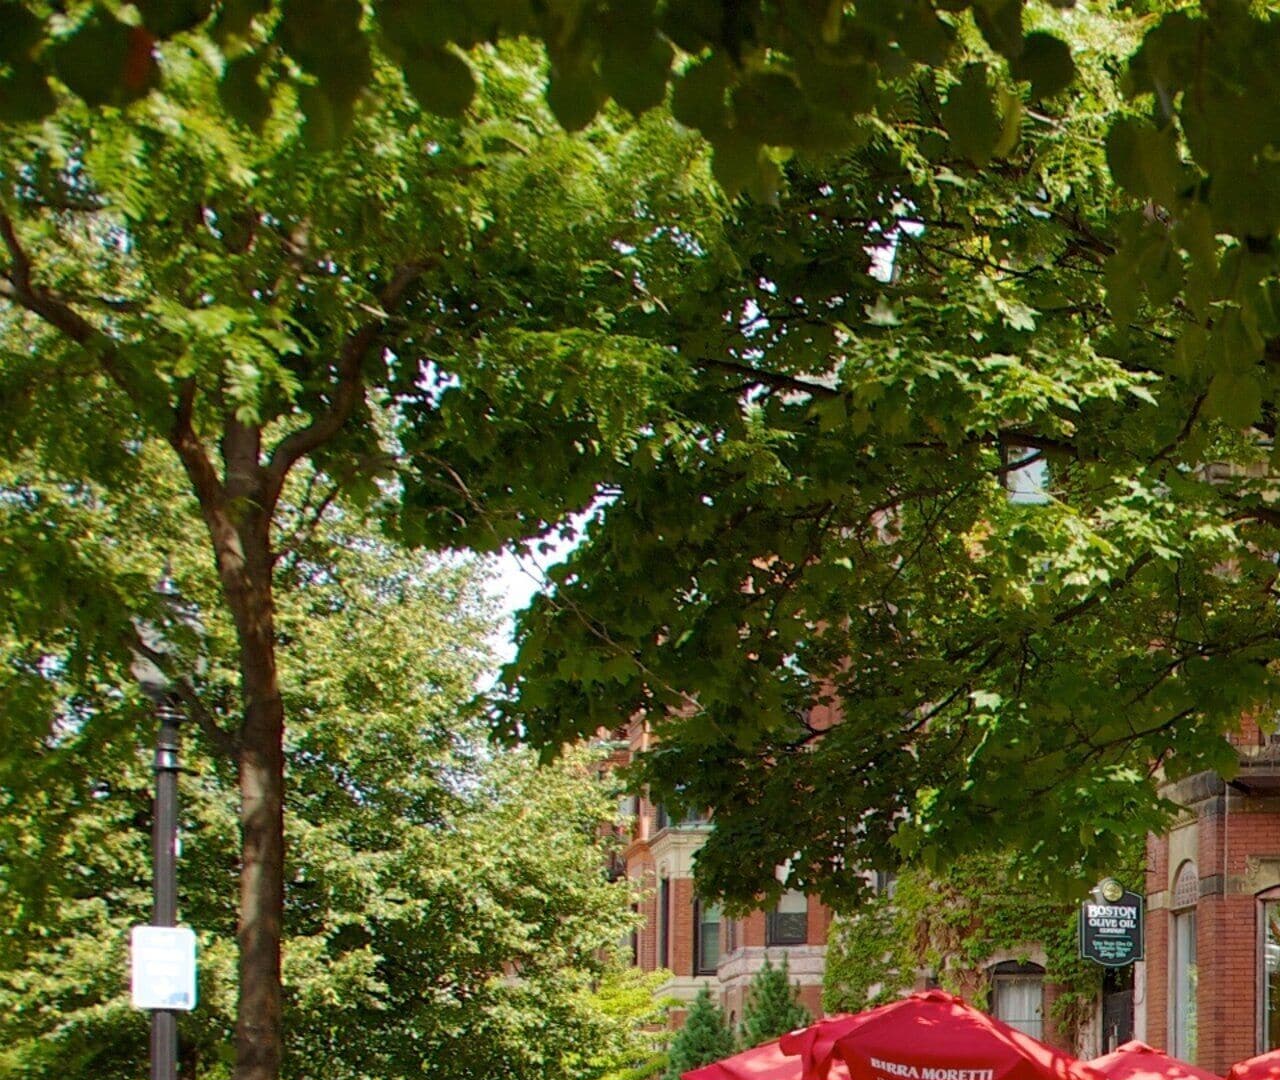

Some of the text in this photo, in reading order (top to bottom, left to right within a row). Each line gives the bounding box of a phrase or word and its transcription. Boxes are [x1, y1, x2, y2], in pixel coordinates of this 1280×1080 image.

[1087, 905, 1137, 920] BOSTON
[1088, 919, 1137, 928] OLIVE OIL
[870, 1056, 919, 1080] BIRRA
